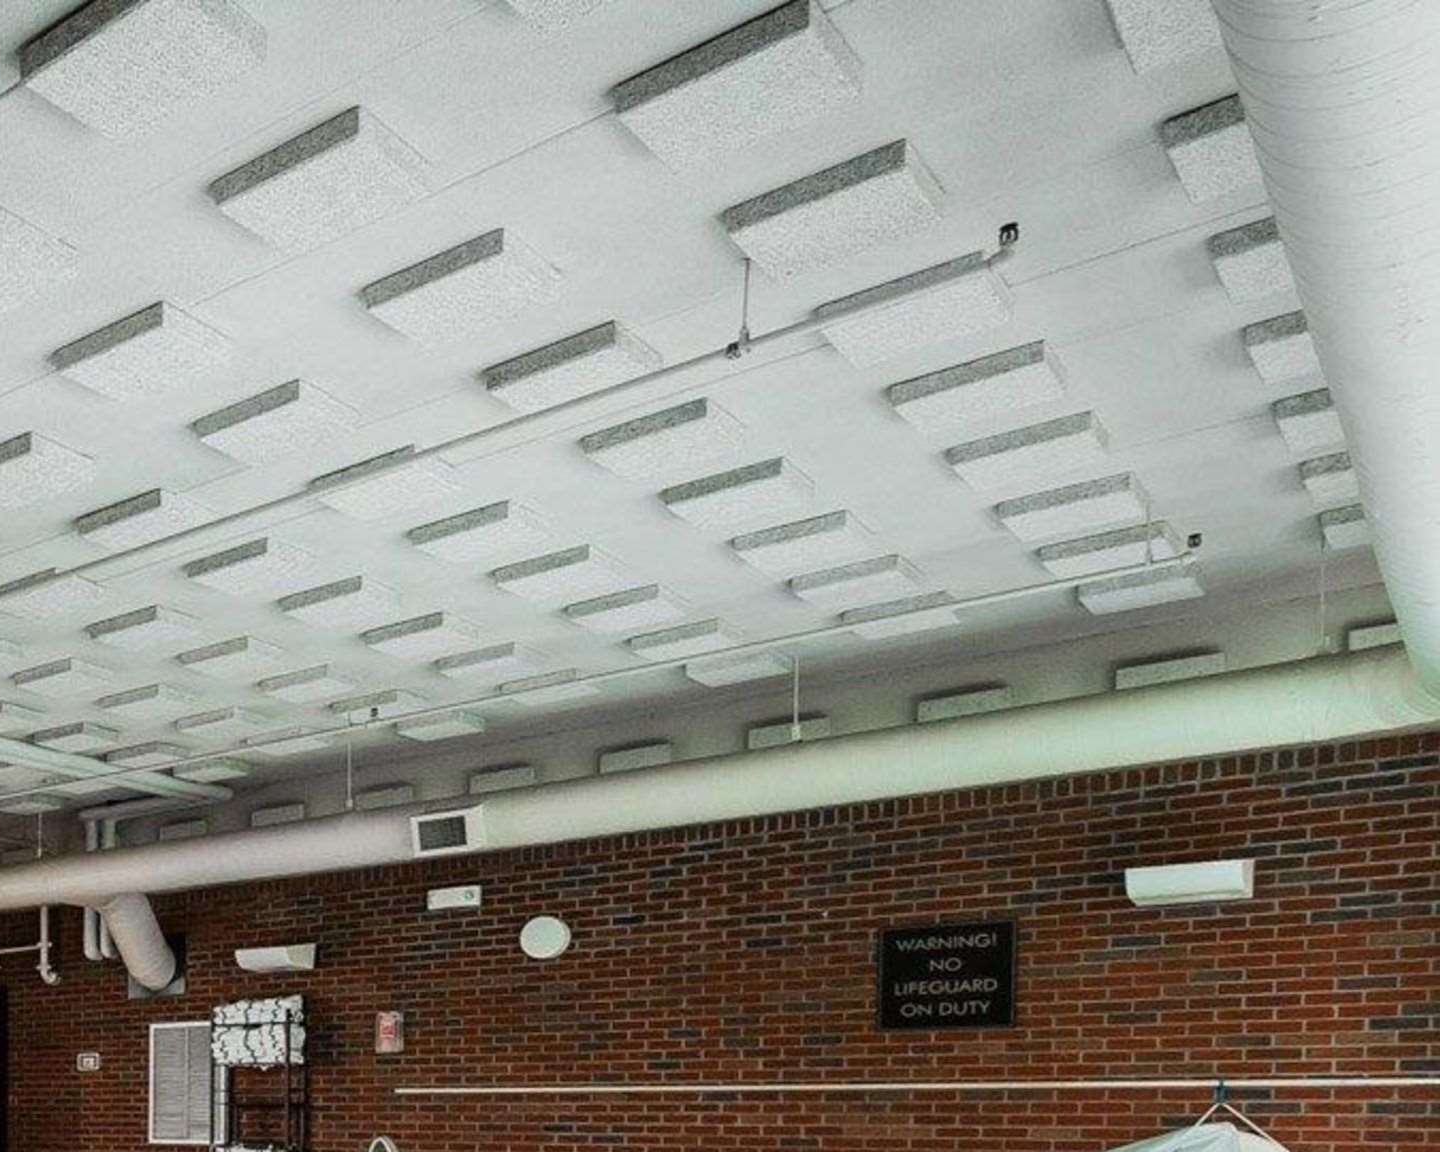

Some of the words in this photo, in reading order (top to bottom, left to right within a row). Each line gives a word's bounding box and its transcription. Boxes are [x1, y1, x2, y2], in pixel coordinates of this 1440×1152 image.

[895, 932, 997, 952] WARNING!
[928, 957, 962, 972] NO
[894, 978, 998, 997] LIFEGUARD
[900, 1003, 932, 1018] ON
[939, 1000, 991, 1017] DUTY
